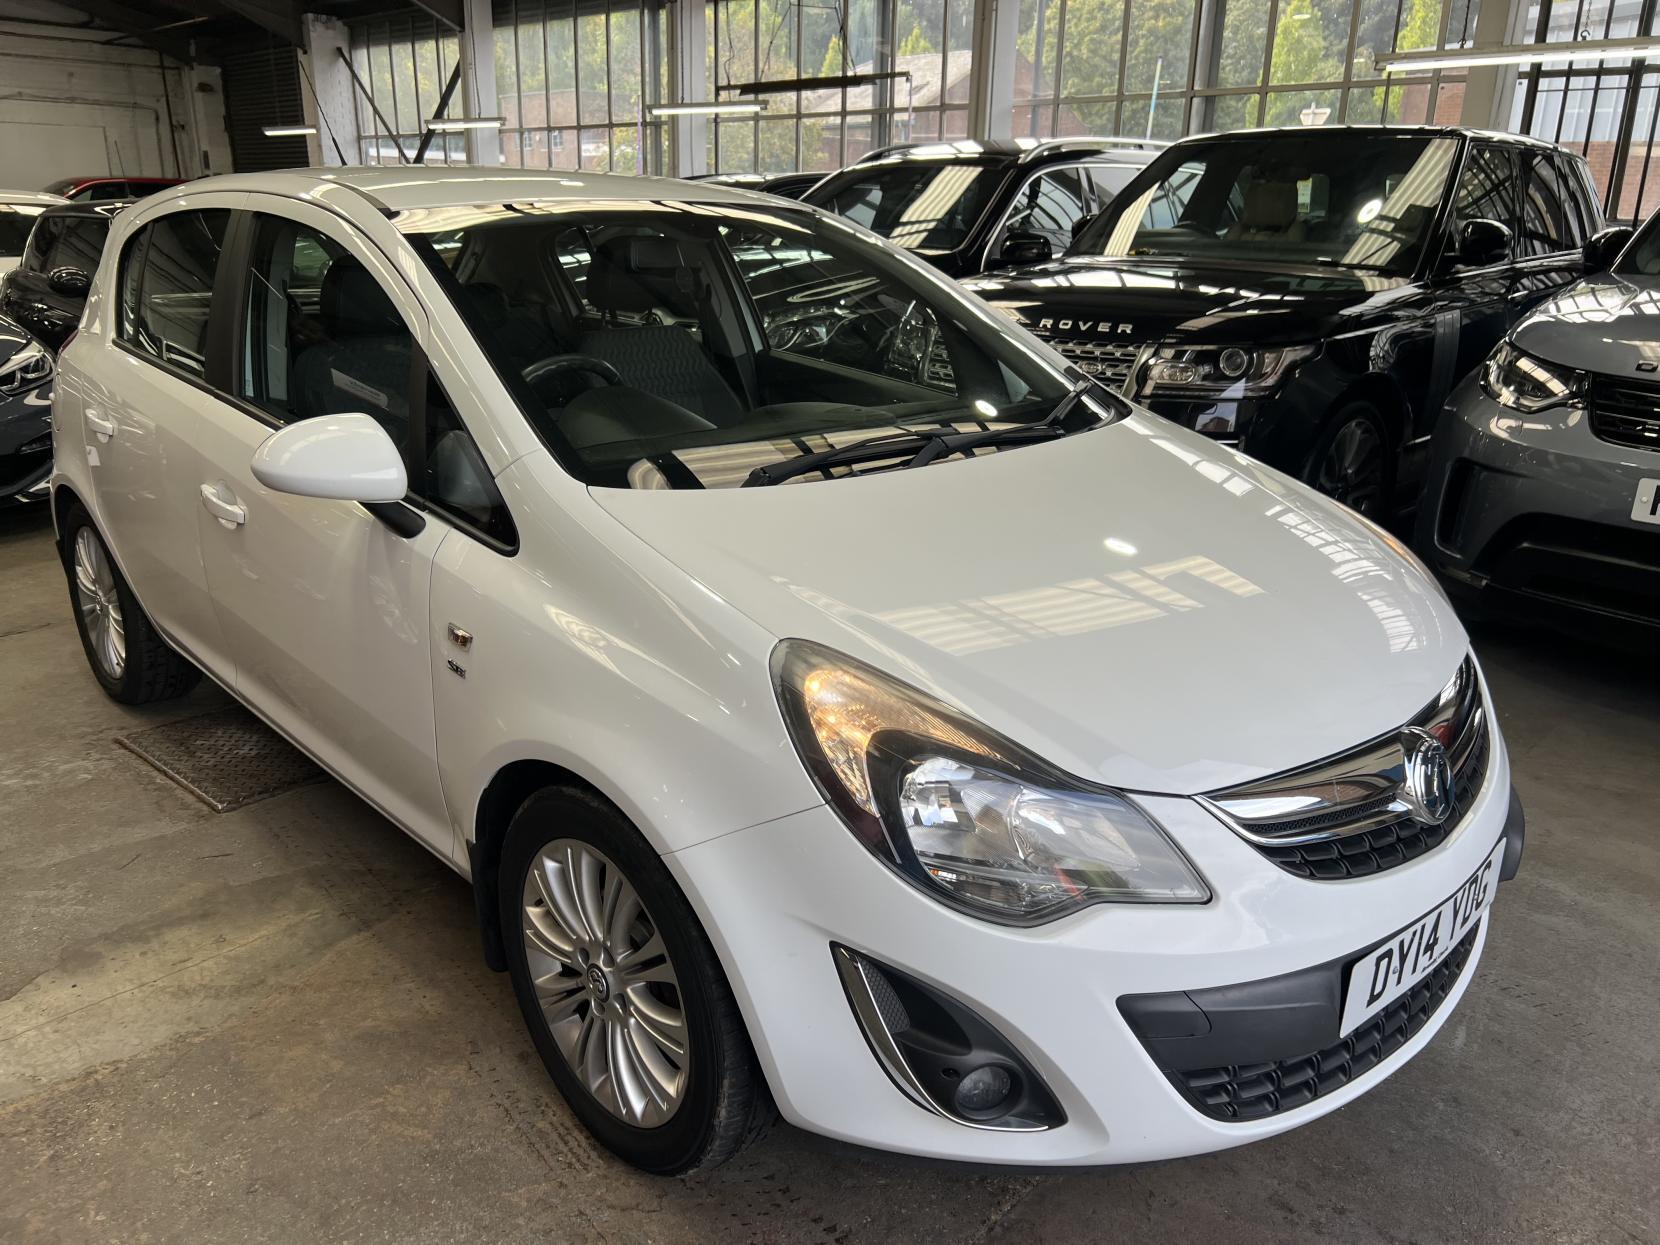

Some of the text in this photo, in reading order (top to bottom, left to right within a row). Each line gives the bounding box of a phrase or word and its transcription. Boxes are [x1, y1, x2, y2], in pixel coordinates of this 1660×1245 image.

[1039, 318, 1133, 334] ROVER
[1366, 858, 1492, 1008] DY14 YDG
